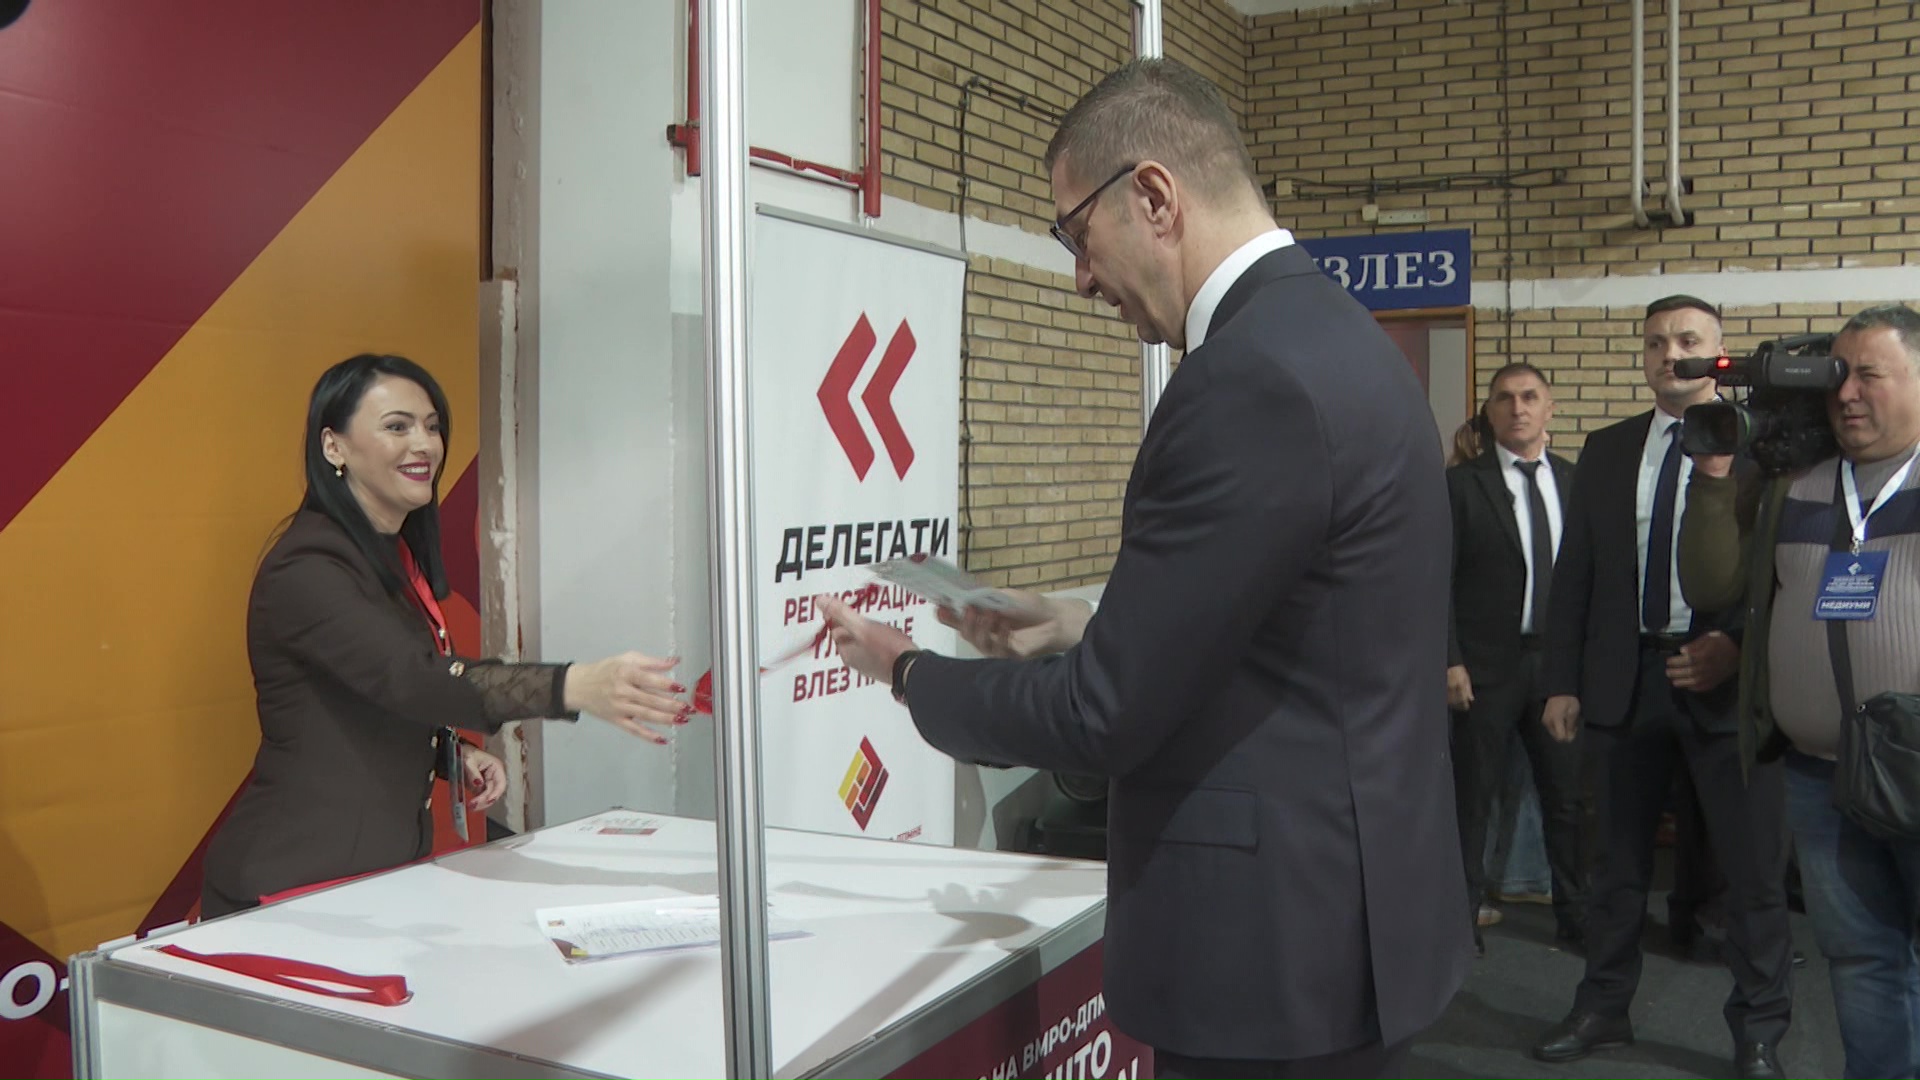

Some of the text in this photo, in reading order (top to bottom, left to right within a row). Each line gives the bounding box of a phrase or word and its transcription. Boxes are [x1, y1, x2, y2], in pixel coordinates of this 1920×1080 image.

[1313, 250, 1457, 291] ЗЛЕЗ
[774, 517, 949, 583] ДЕЛЕГАТИ
[1821, 601, 1871, 610] МЕДИУМИ
[793, 665, 851, 703] ВЛЕЗ
